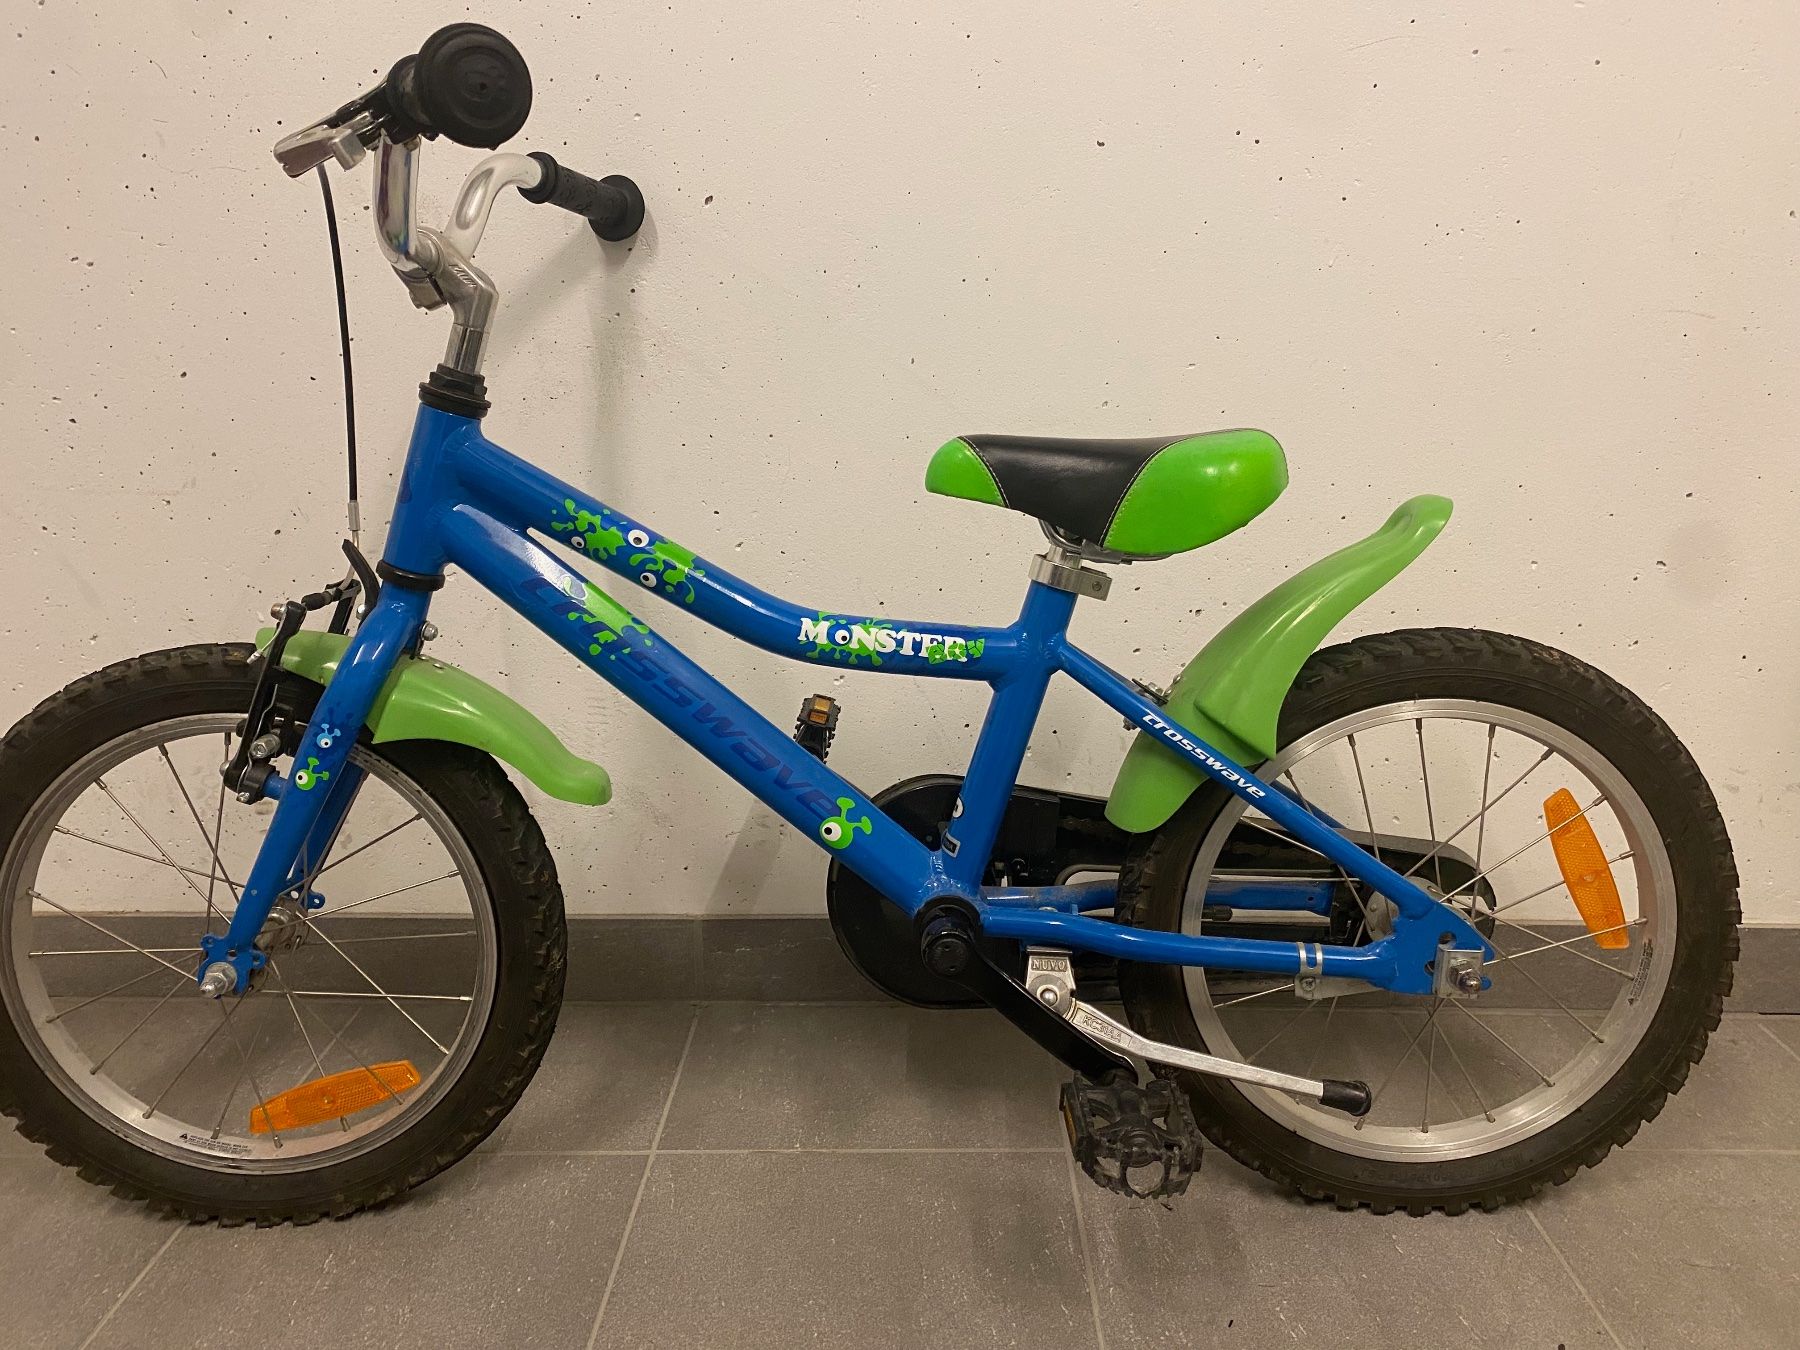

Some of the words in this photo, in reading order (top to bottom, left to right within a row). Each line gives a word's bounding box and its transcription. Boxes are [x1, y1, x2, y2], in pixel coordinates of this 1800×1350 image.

[797, 618, 968, 662] MONSTER
[1142, 714, 1266, 799] crosswave
[1032, 959, 1066, 970] NUVO
